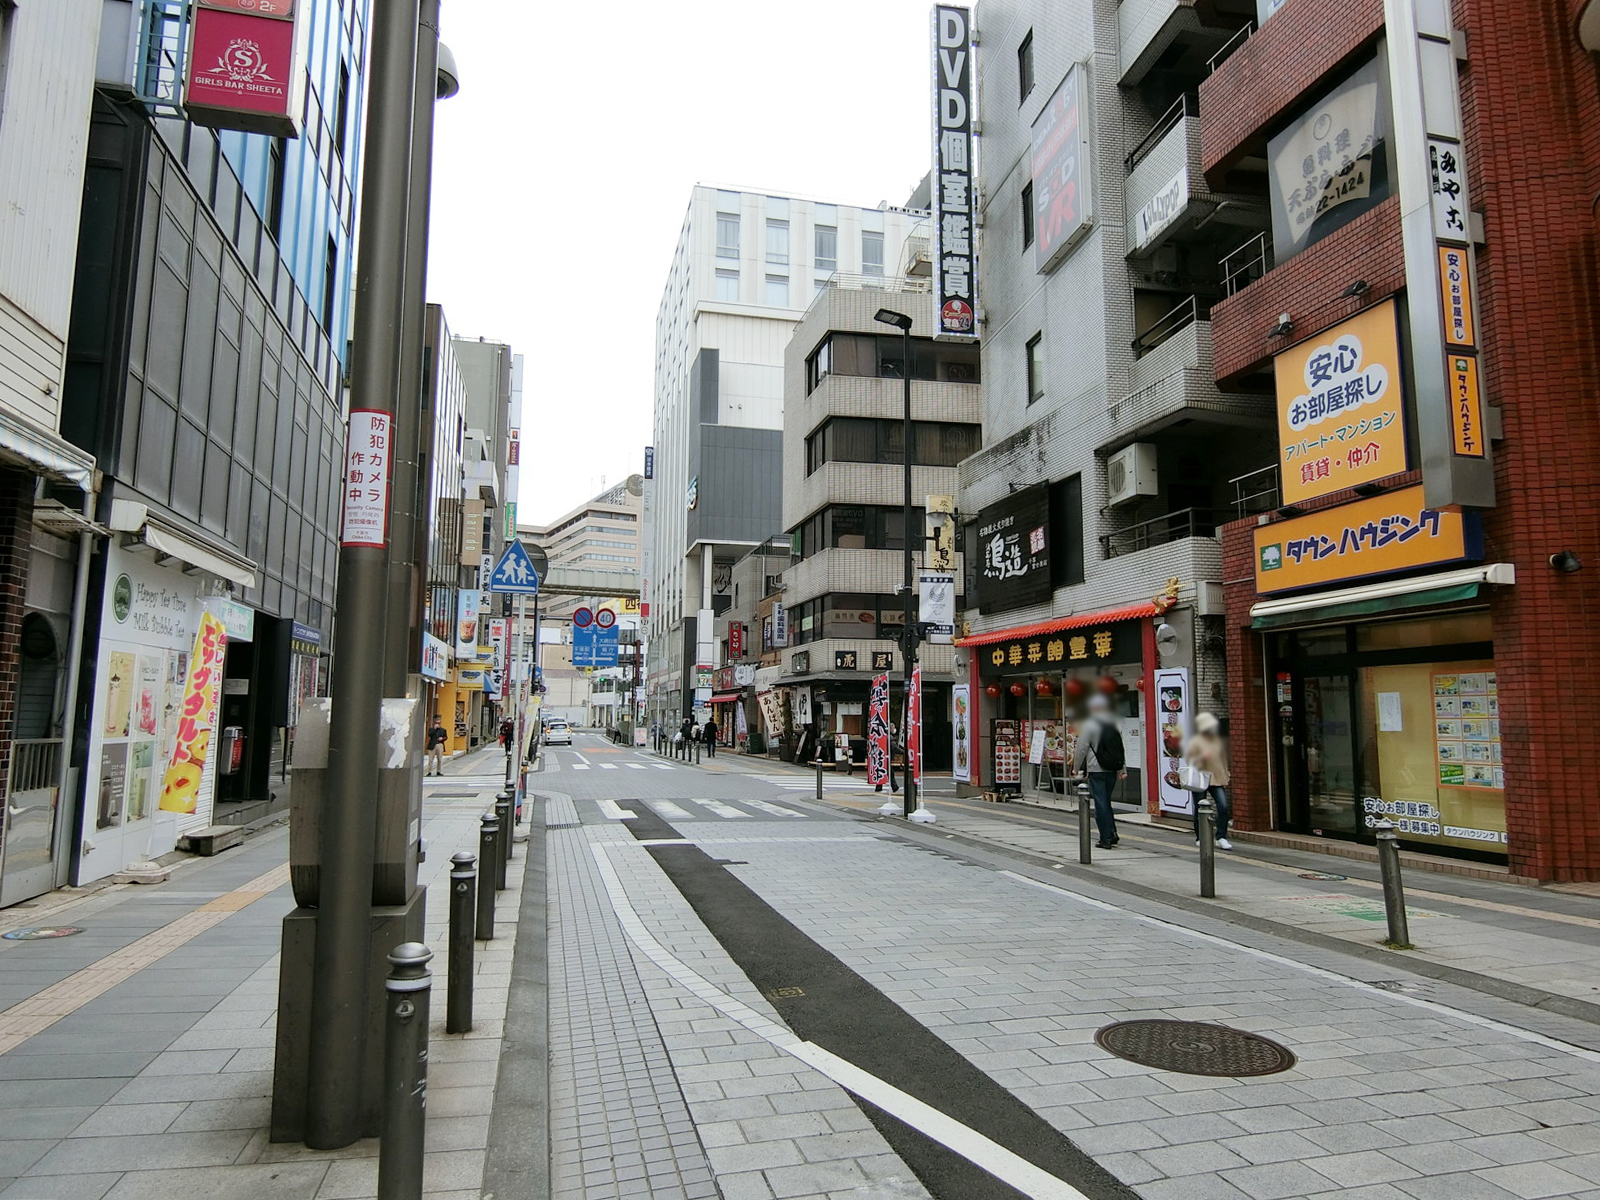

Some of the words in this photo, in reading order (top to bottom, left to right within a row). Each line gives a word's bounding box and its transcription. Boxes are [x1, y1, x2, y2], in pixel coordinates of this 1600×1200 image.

[259, 0, 276, 12] 2F
[233, 50, 253, 67] S
[195, 76, 224, 87] GIRLS
[224, 80, 245, 90] BAR
[246, 83, 283, 95] SHEETA
[1142, 180, 1180, 236] LOLLYPOP
[1447, 253, 1463, 340] 安心お部屋探し
[1309, 344, 1358, 388] 安心
[1291, 374, 1382, 426] お部屋探し
[1458, 374, 1475, 452] タウンハウジング
[1285, 412, 1396, 461] アパート・マンション
[349, 451, 365, 502] 作動中
[367, 416, 386, 503] 防犯カメラ
[1300, 442, 1380, 485] 賃貸・仲介
[1286, 509, 1447, 564] タウンハウジング
[600, 614, 612, 623] 40
[874, 654, 888, 668] 屋
[171, 622, 215, 768] エッグタルト
[1364, 798, 1440, 819] 安心お部屋探し
[1411, 819, 1440, 837] 募集中
[1446, 827, 1496, 840] タウンハウジング
